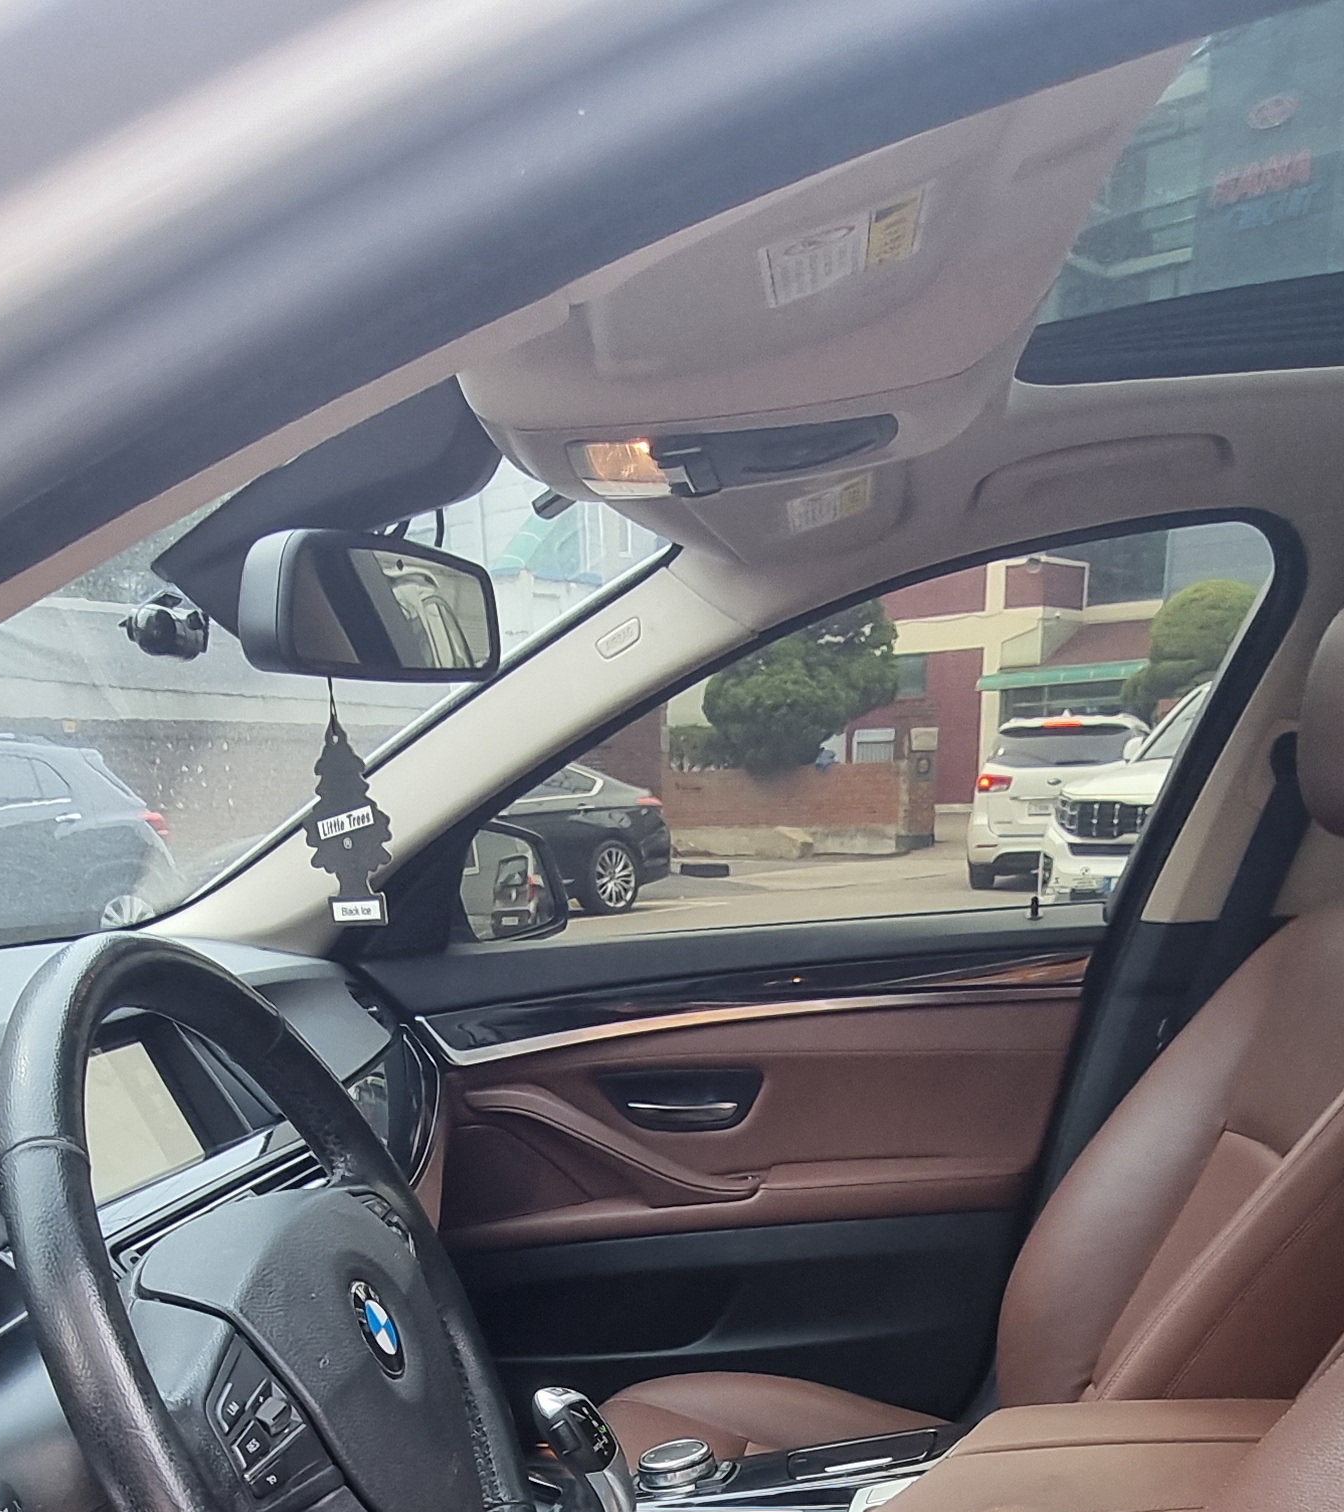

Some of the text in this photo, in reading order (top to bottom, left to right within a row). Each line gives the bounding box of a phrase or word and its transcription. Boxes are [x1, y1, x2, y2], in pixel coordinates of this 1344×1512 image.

[321, 812, 371, 837] Little Trees
[341, 907, 359, 917] Black
